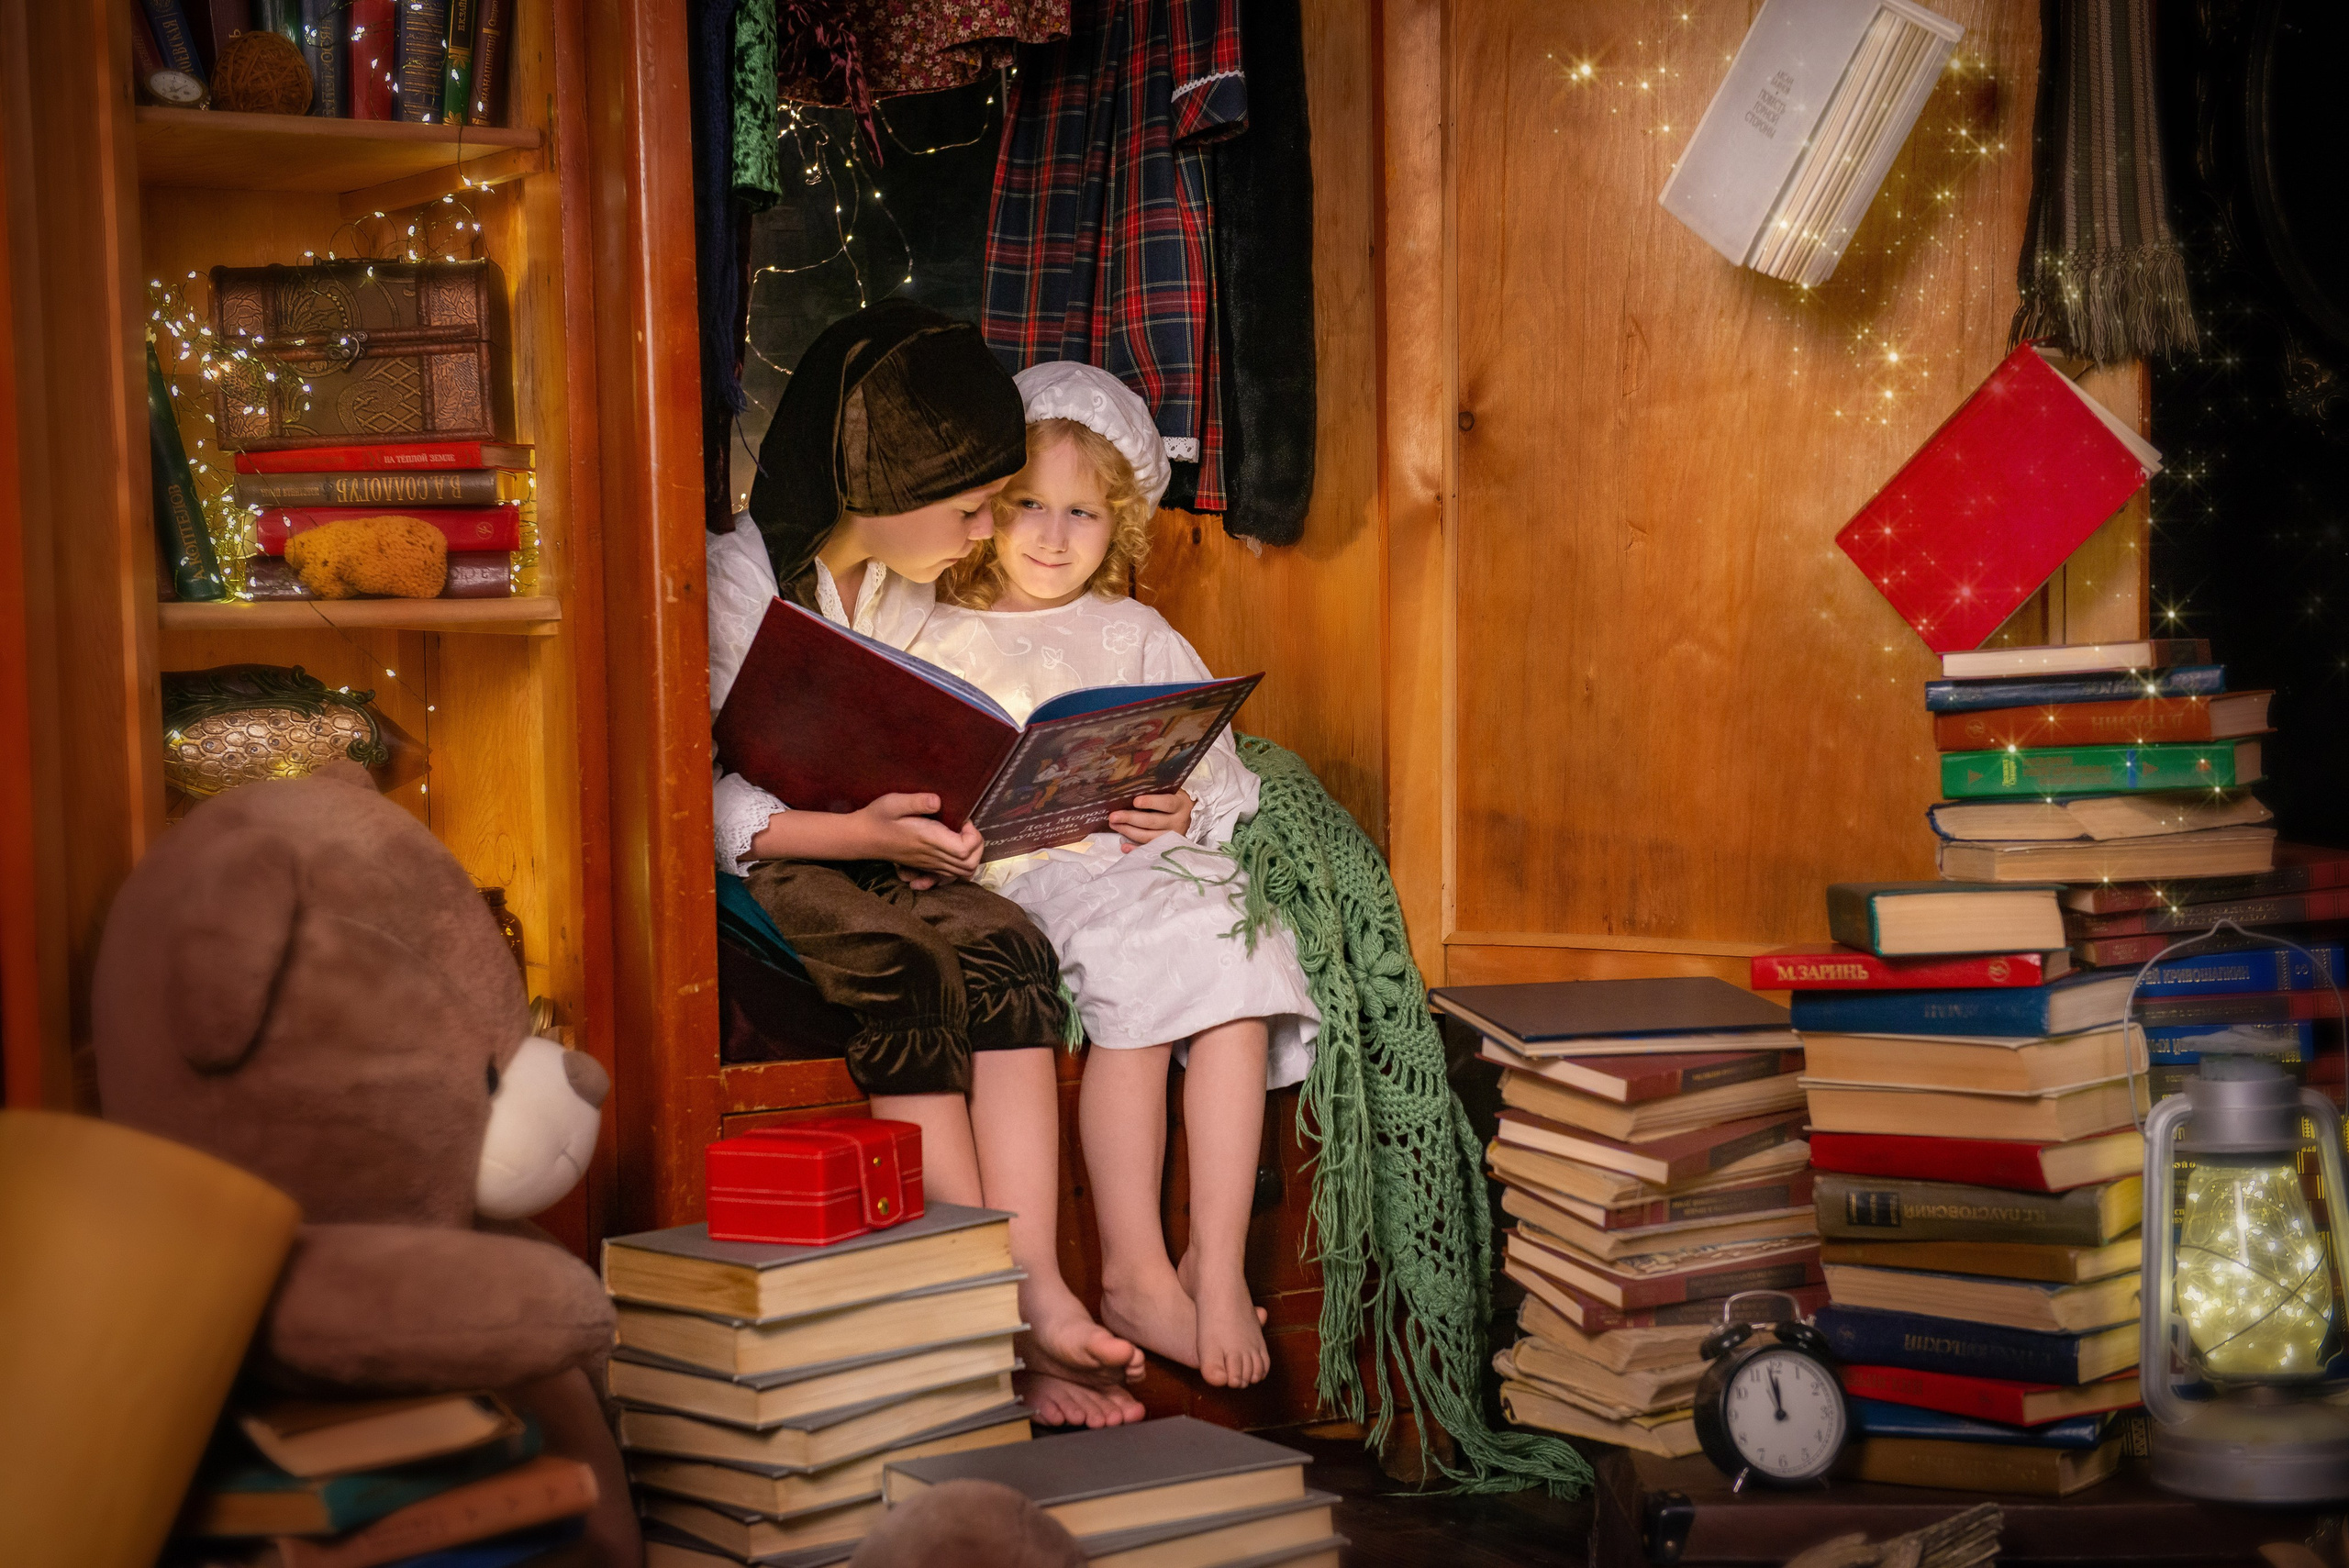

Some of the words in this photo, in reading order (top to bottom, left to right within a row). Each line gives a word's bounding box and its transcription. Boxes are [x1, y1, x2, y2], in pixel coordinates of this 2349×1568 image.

[1019, 822, 1051, 834] Дед
[1057, 809, 1109, 823] Мороз,
[1750, 1368, 1761, 1382] 11
[1736, 1386, 1748, 1399] 10
[1810, 1382, 1820, 1396] 2
[1820, 1406, 1829, 1419] 3
[1738, 1432, 1747, 1445] 8
[1814, 1429, 1822, 1442] 4
[1756, 1448, 1765, 1462] 7
[1778, 1454, 1788, 1468] 6
[1801, 1448, 1809, 1461] 5
